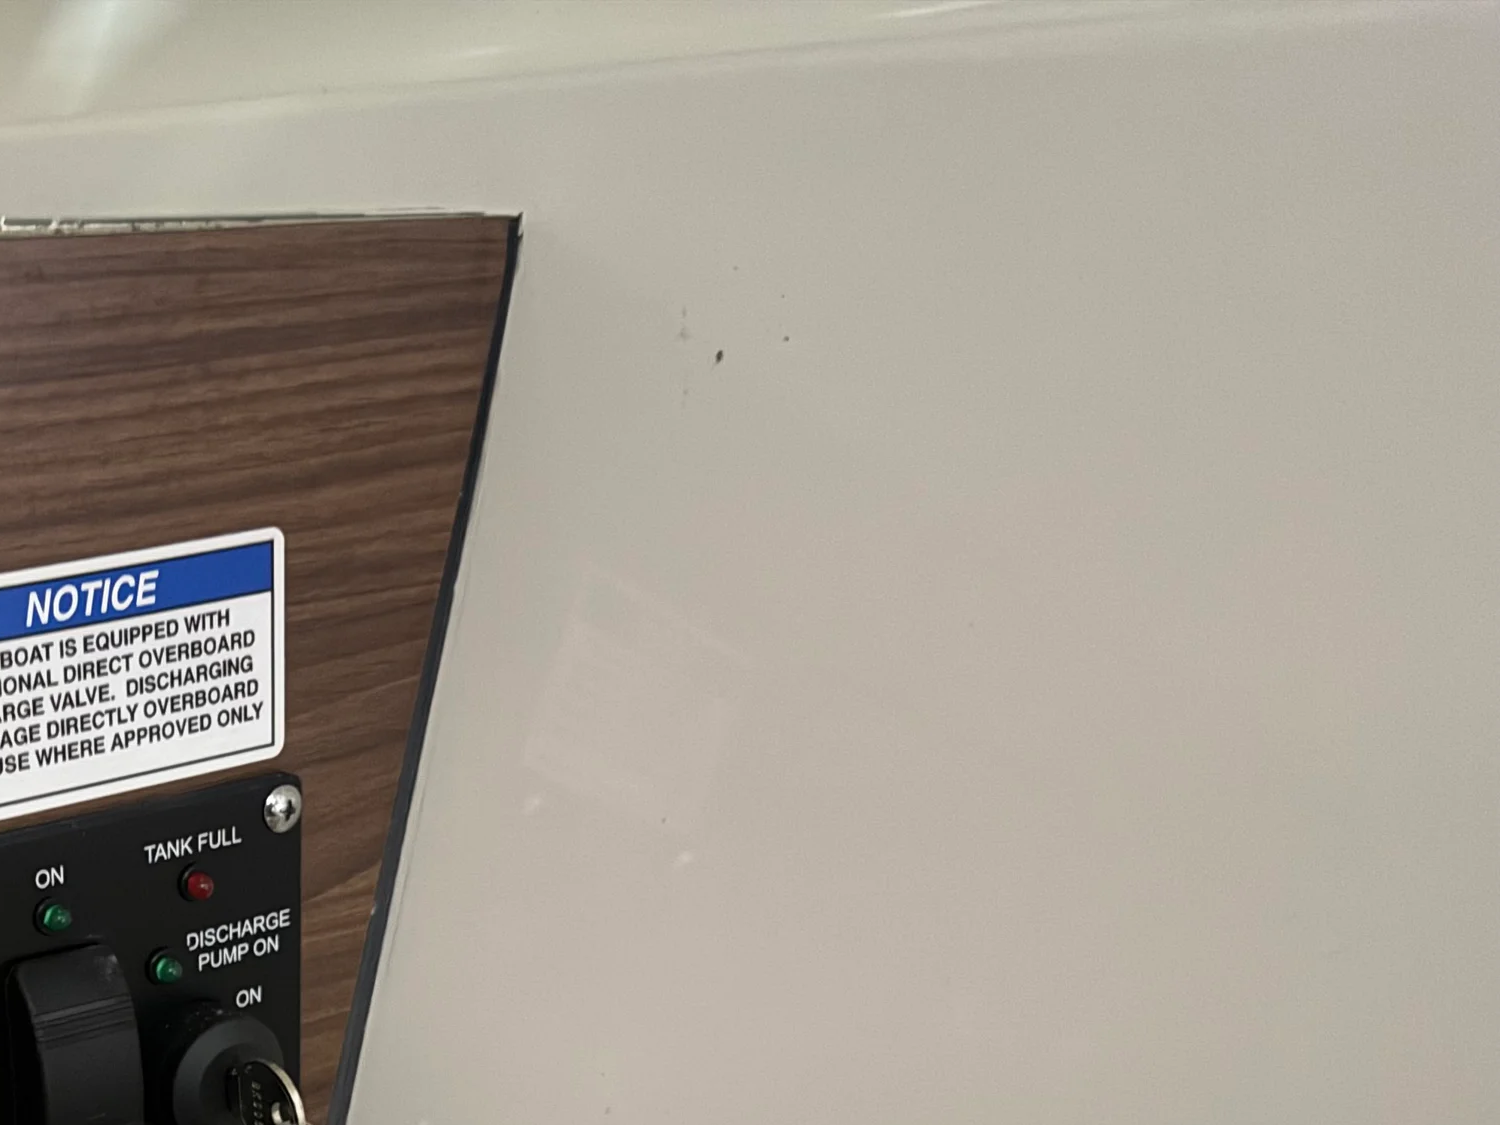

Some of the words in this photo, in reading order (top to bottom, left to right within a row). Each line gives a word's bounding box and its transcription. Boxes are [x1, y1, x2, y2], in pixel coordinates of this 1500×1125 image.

[26, 570, 159, 627] NOTICE
[0, 642, 54, 670] BOAT
[60, 639, 77, 659] IS
[83, 618, 179, 654] EQUIPPED
[184, 608, 230, 634] WITH
[64, 651, 134, 684] DIRECT
[139, 629, 256, 668] OVERBOARD
[47, 703, 139, 740] DIRECTLY
[144, 678, 259, 716] OVERBOARD
[50, 682, 116, 713] VALVE.
[127, 654, 254, 698] DISCHARGING
[36, 735, 106, 767] WHERE
[111, 716, 212, 752] APPROVED
[217, 701, 264, 729] ONLY
[144, 835, 193, 864] TANK
[198, 826, 242, 852] FULL
[35, 866, 65, 889] ON
[186, 908, 291, 951] DISCHARGE
[198, 945, 249, 972] PUMP
[254, 935, 279, 957] ON
[236, 986, 262, 1008] ON
